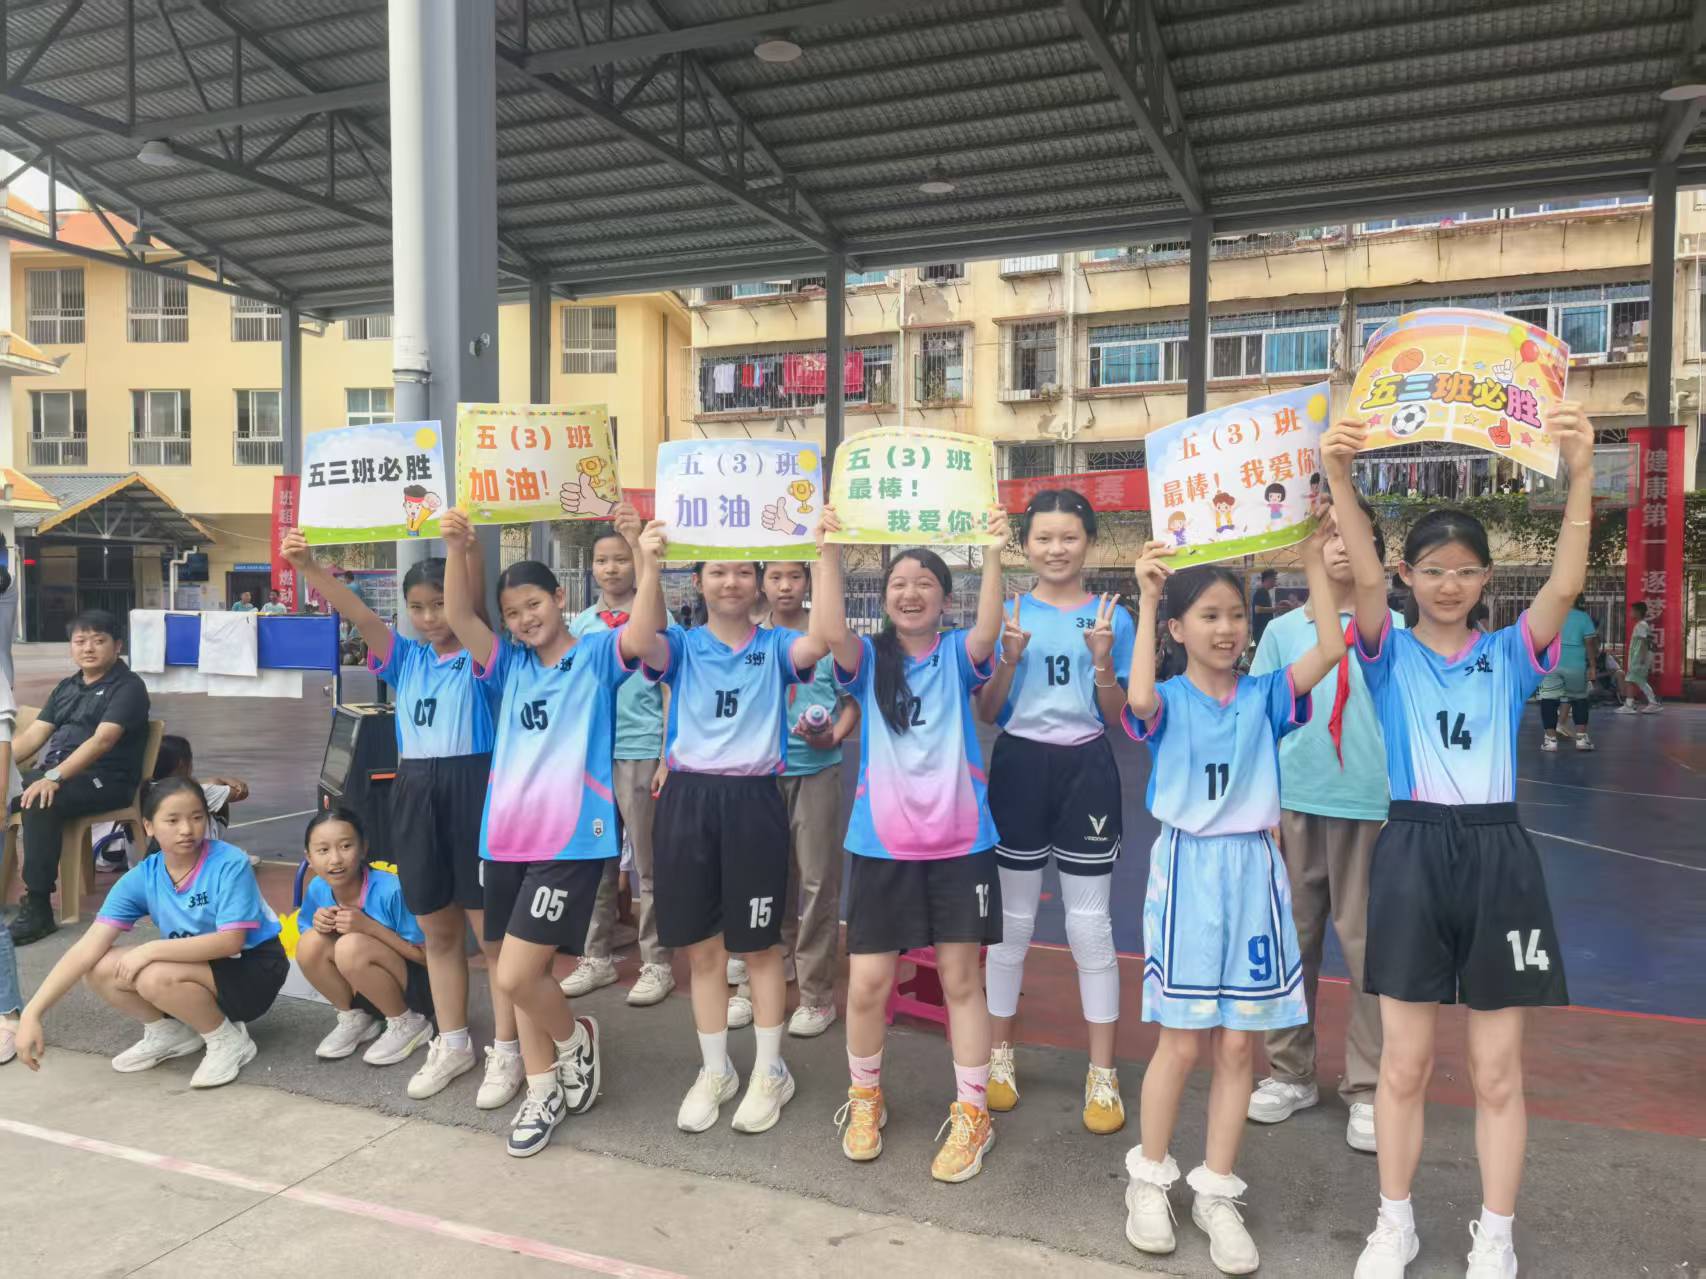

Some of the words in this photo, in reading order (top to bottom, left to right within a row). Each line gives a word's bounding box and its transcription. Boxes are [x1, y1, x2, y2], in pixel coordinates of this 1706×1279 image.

[1360, 372, 1542, 429] 五三班必胜
[476, 425, 594, 451] 五（3）班
[1178, 407, 1302, 462] 五（3）班
[307, 453, 433, 488] 五三班必胜
[679, 452, 800, 476] 五（3）班
[846, 446, 973, 471] 五（3）班
[469, 467, 550, 502] 加油！
[847, 477, 919, 499] 最棒！
[675, 494, 750, 528] 加油
[1045, 655, 1070, 686] 13
[414, 698, 437, 727] 07
[520, 700, 548, 730] 05
[715, 688, 740, 718] 15
[1436, 711, 1472, 750] 14
[1205, 763, 1229, 800] 11
[188, 891, 209, 908] 3班
[530, 885, 568, 922] 05
[749, 896, 773, 928] 15
[1247, 934, 1272, 981] 9
[1506, 928, 1550, 971] 14
